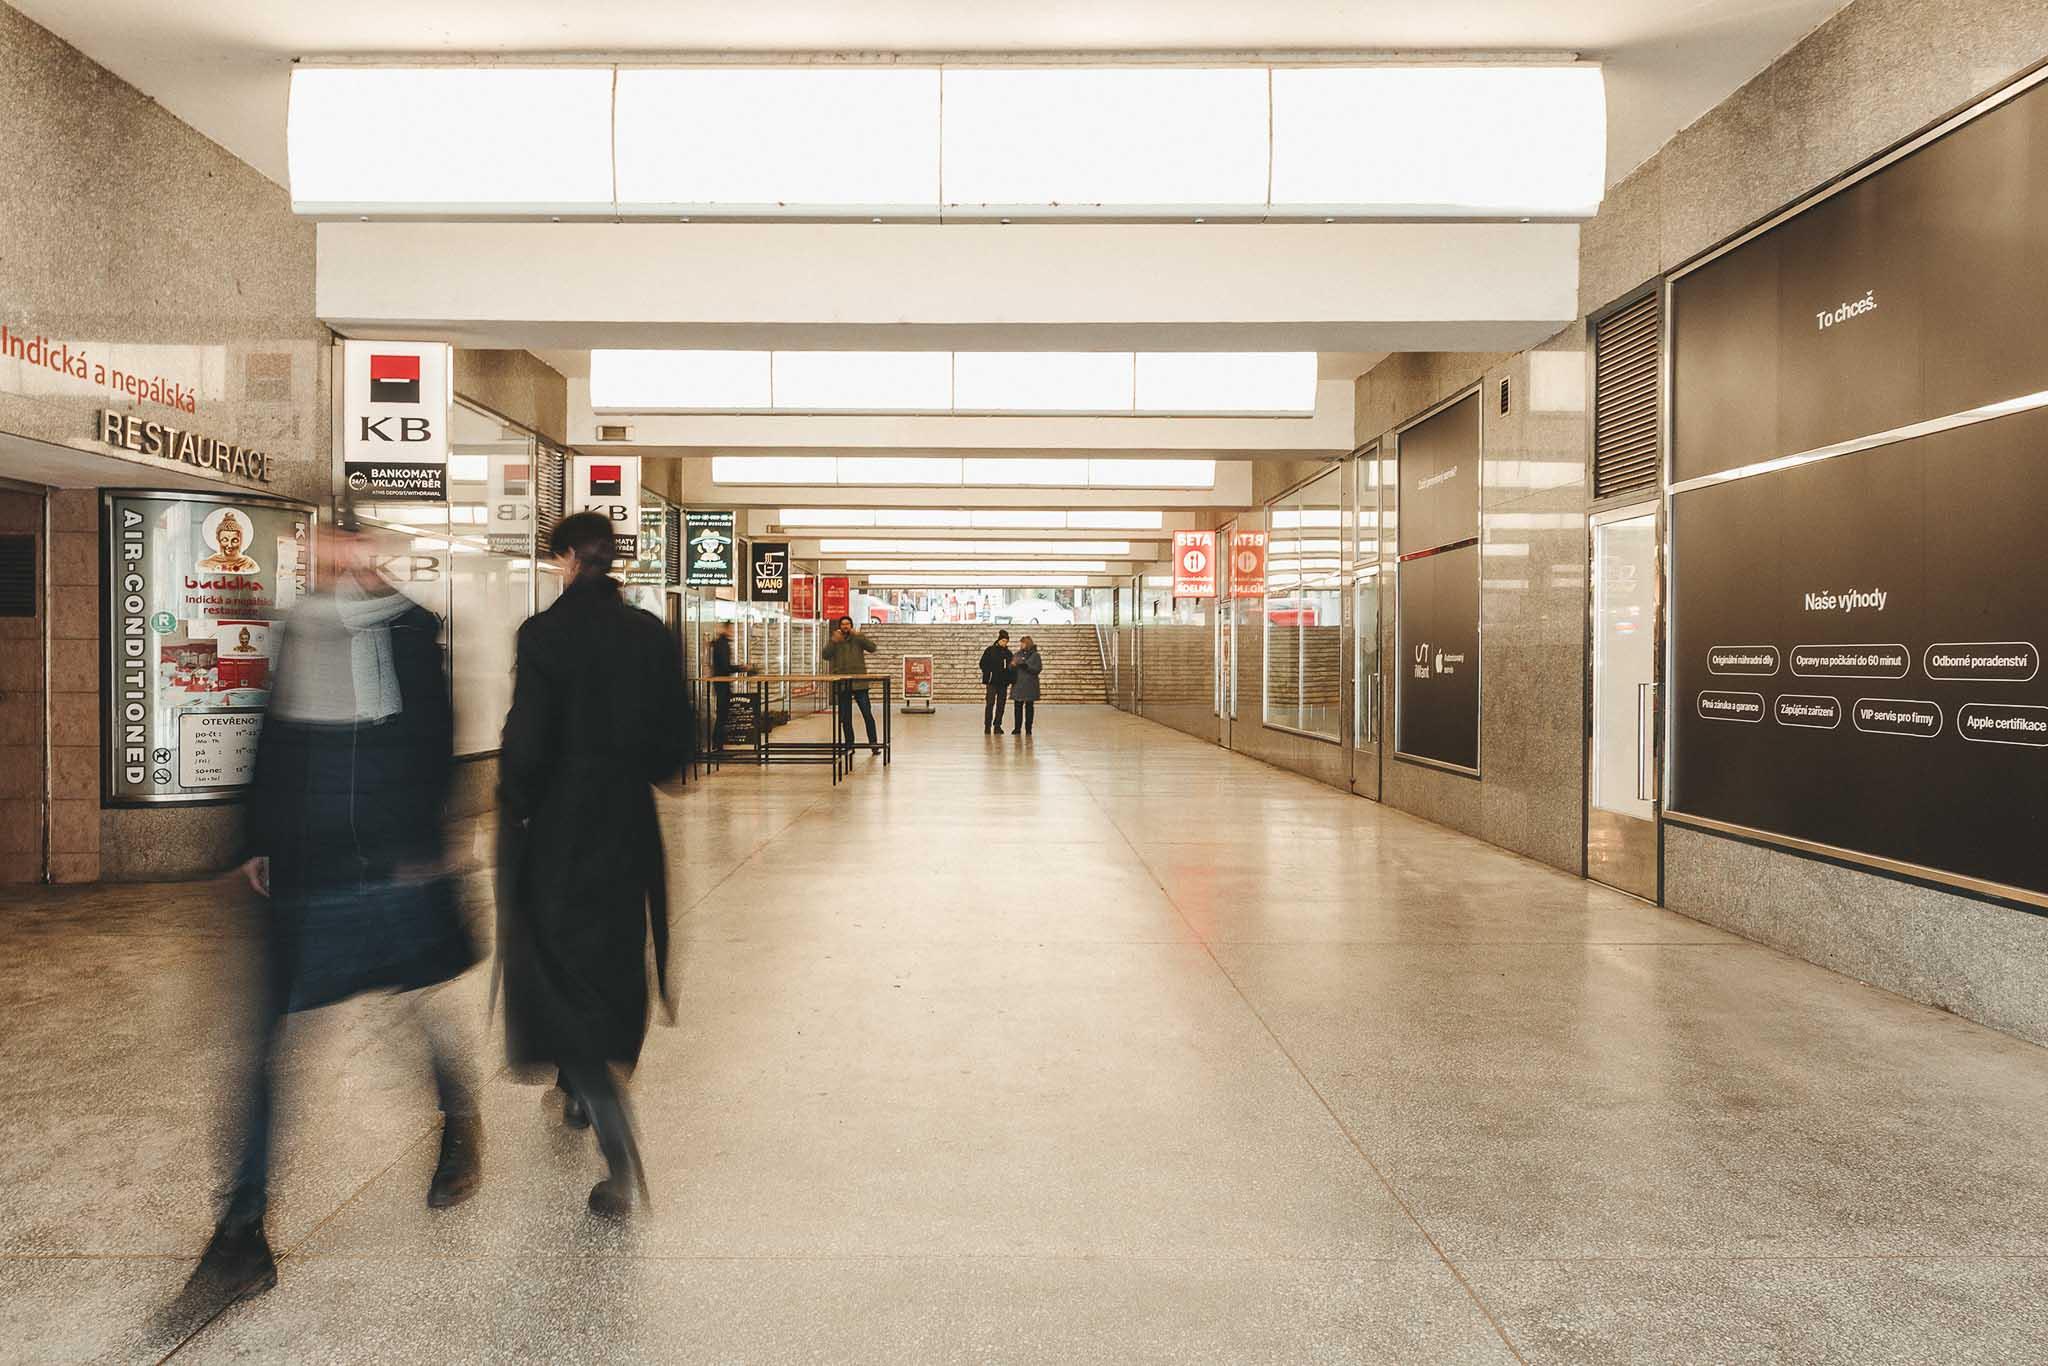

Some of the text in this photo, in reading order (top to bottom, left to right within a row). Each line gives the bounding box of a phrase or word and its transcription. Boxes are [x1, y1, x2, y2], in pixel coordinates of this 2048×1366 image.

[1816, 290, 1878, 330] To chceš.
[2, 325, 195, 415] Indická a nepálská
[360, 416, 432, 443] KB
[103, 408, 274, 483] RESTAURACE
[371, 468, 442, 479] BANKOMATY
[371, 478, 441, 489] VKLAD/VÝBĚR
[1176, 533, 1213, 546] BETA
[184, 575, 264, 591] buddha
[756, 578, 783, 589] WANG
[185, 594, 223, 604] Indická
[1805, 587, 1888, 613] Naše výhody
[158, 613, 169, 626] R
[122, 509, 146, 786] AIR-CONDITIONED
[1712, 654, 1774, 667] Originální náhradní díly
[1796, 654, 1902, 667] Opravy na počkání do 60 minut
[1932, 653, 2029, 669] Odborné poradenství
[1736, 703, 1760, 712] garance
[1860, 708, 1934, 727] VIP servis pro firmy
[1967, 714, 2047, 732] Apple certifikace
